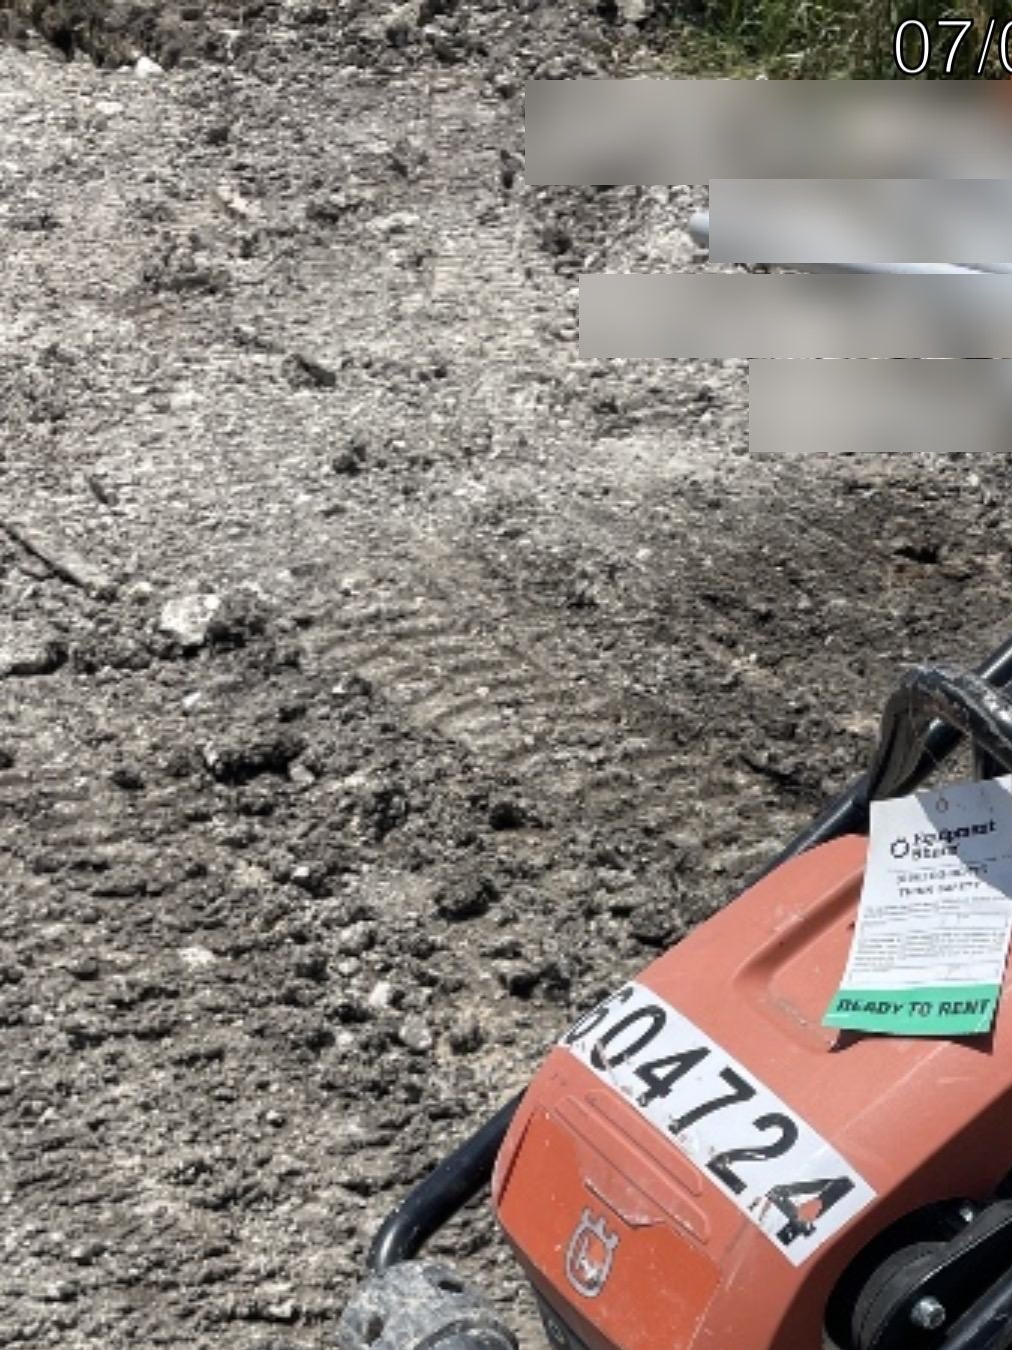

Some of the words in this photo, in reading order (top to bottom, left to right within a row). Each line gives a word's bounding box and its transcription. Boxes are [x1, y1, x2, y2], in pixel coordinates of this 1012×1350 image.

[836, 998, 904, 1016] READY
[908, 1001, 934, 1017] TO
[938, 999, 991, 1017] RENT
